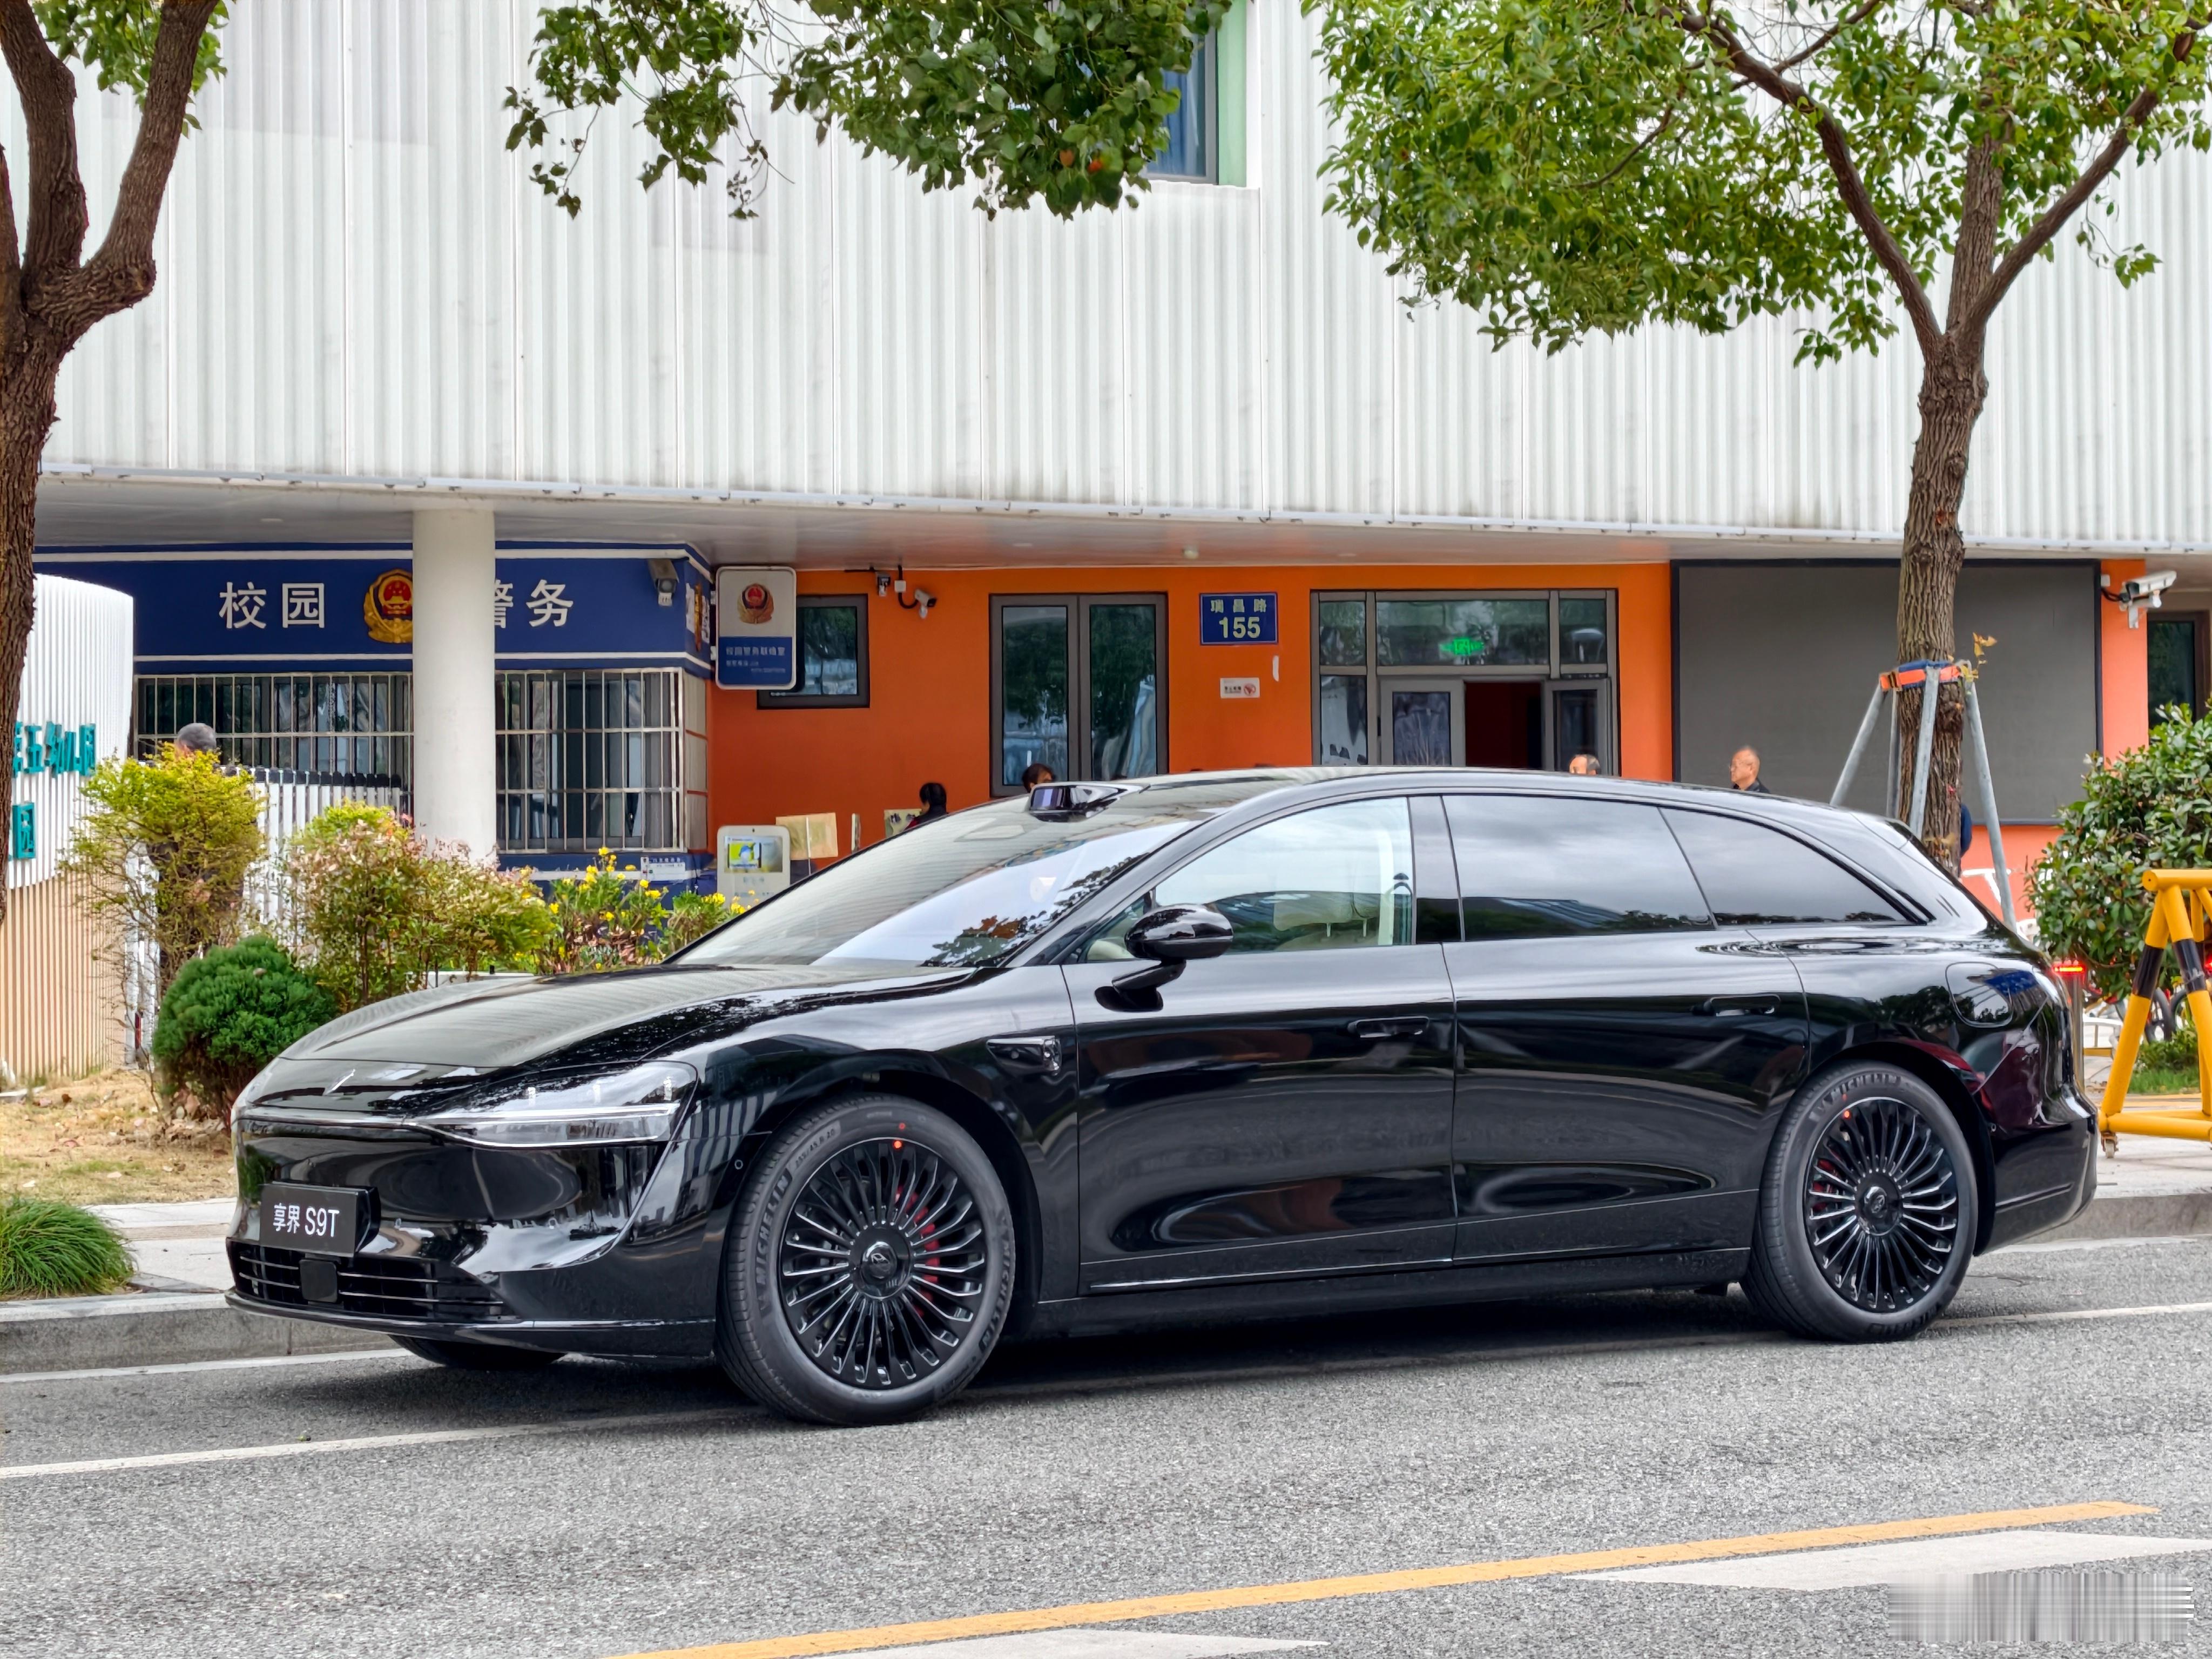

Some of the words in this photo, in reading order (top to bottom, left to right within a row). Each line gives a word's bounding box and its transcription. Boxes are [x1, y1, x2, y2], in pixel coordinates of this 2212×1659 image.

[219, 582, 325, 629] 校园
[1219, 616, 1260, 639] 155
[9, 802, 36, 860] 园
[273, 1203, 300, 1234] 享界
[305, 1206, 340, 1238] S9T
[756, 1174, 788, 1285] MICHELIN
